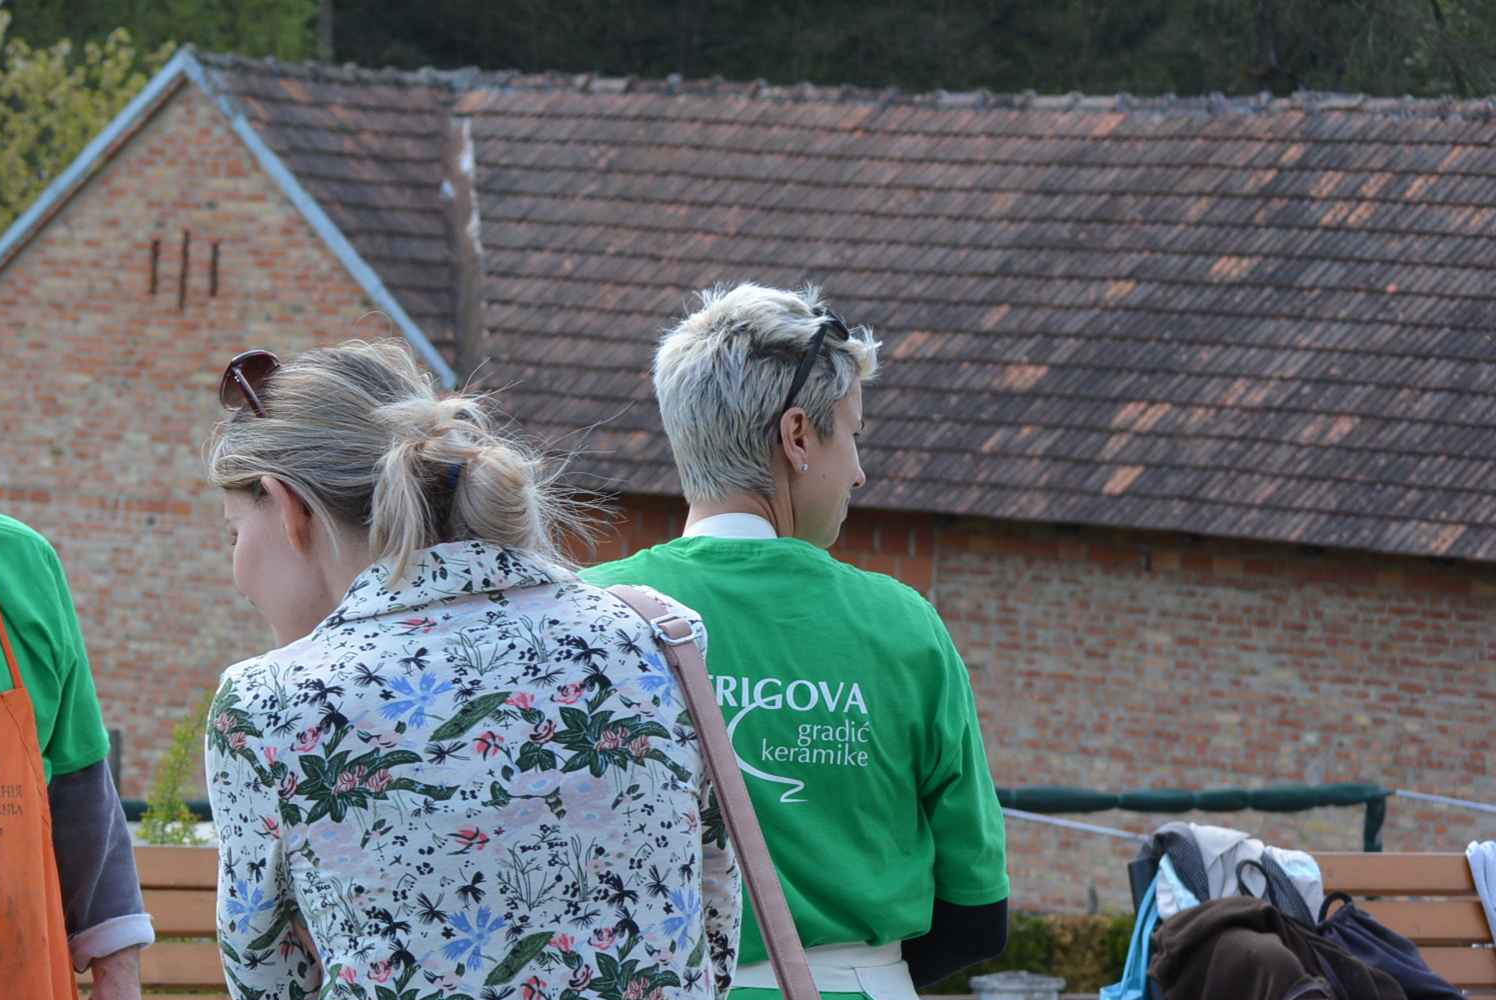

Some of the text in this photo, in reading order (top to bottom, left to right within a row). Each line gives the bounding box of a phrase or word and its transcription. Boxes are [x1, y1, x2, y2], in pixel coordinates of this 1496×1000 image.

[707, 674, 869, 715] RIGOVA
[797, 719, 871, 747] gradić
[761, 738, 869, 767] keramike
